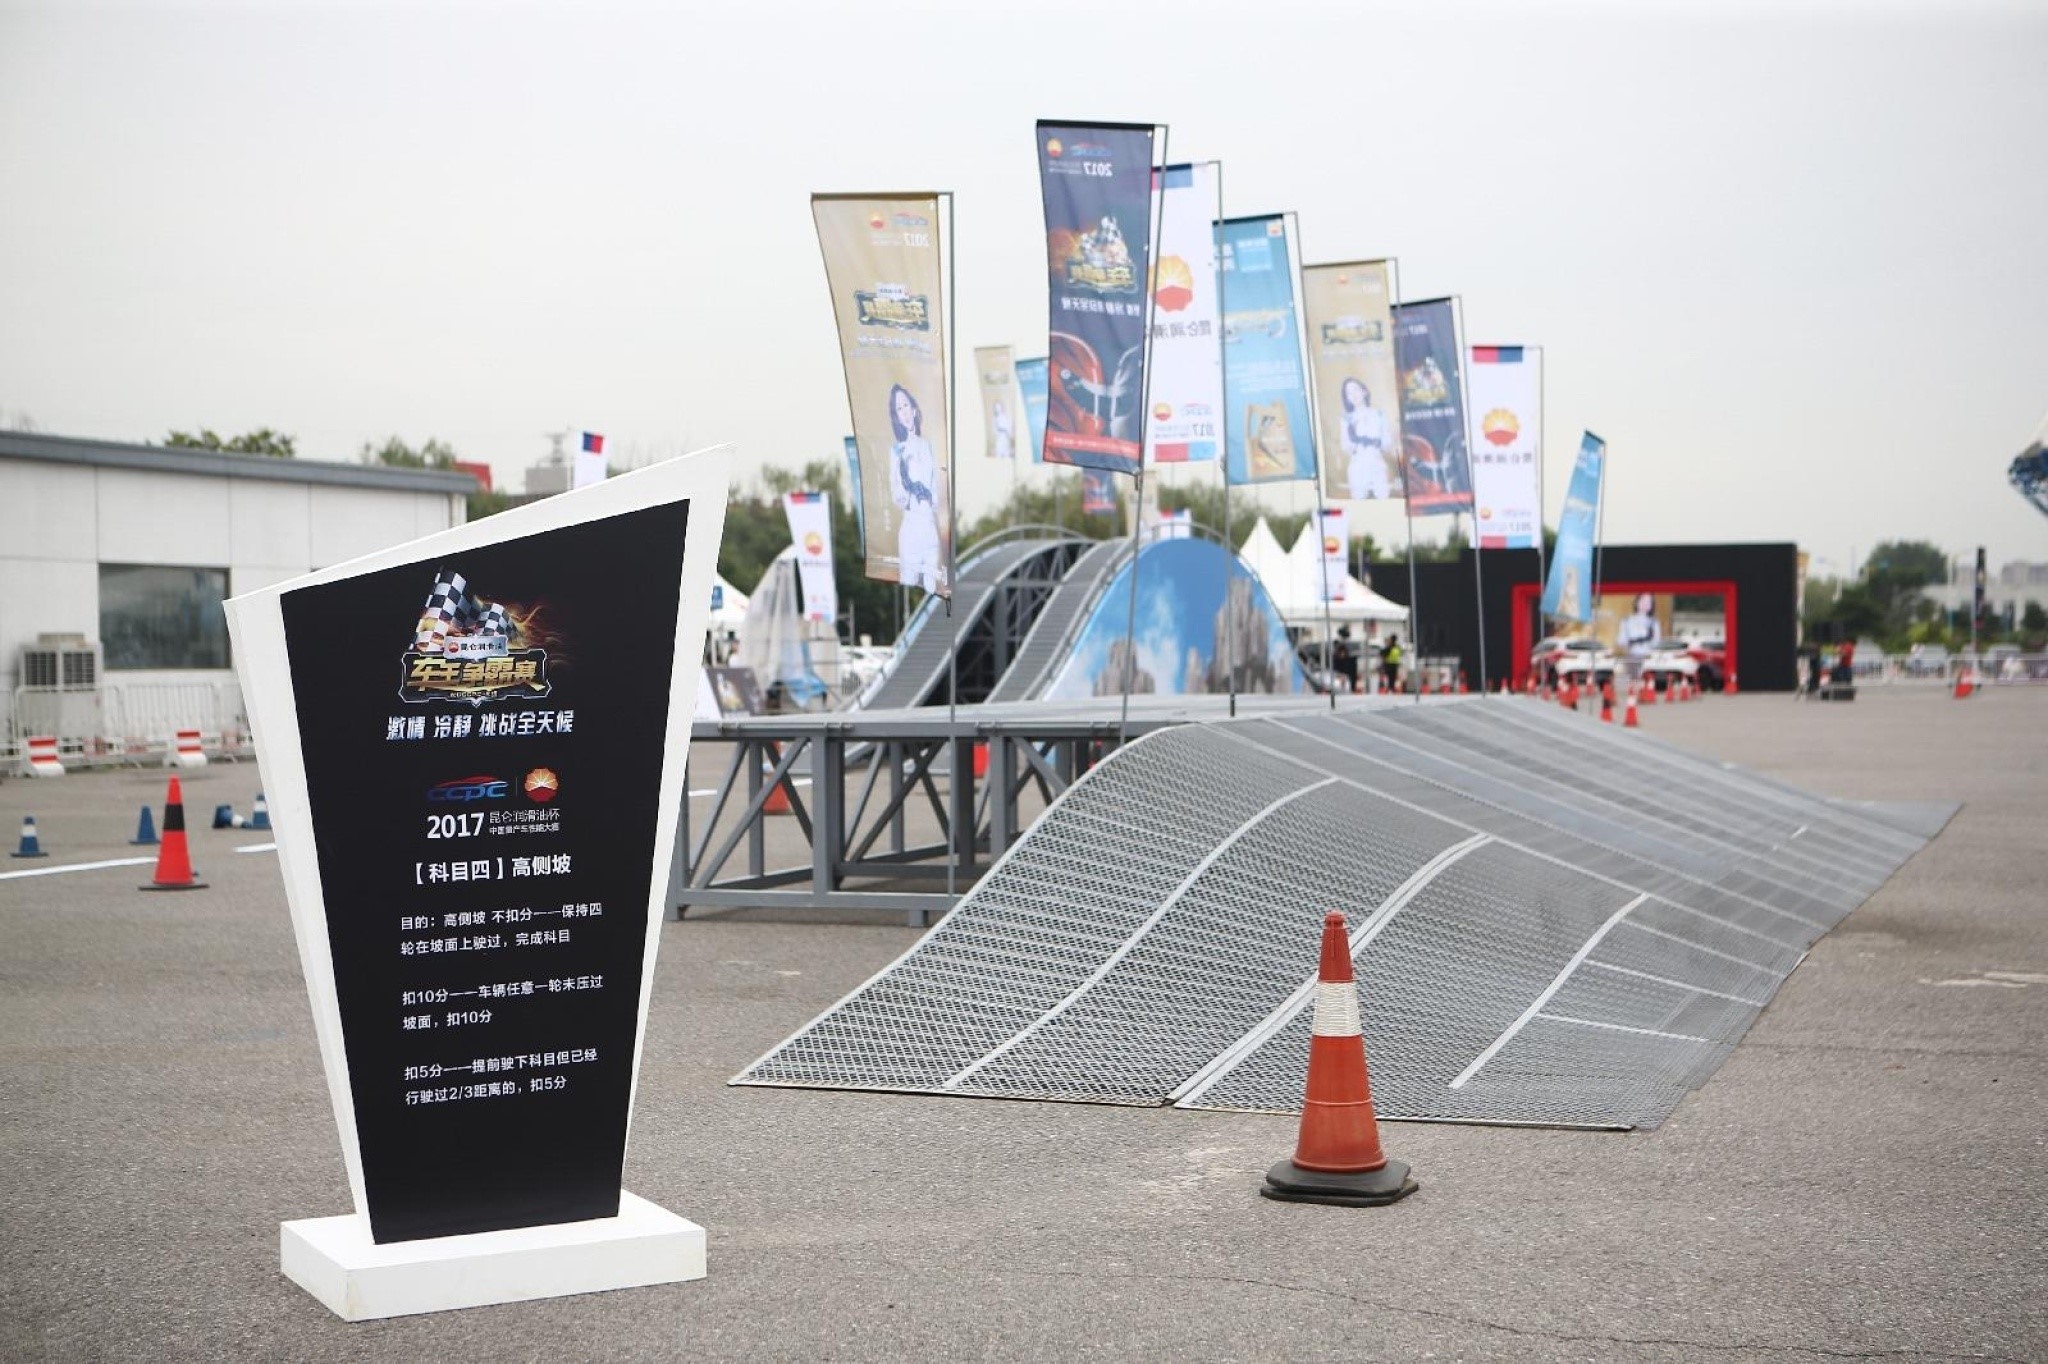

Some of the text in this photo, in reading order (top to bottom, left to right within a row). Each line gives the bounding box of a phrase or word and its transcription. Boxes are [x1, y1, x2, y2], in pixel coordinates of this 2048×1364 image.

[407, 657, 546, 691] 车王争霸赛
[386, 710, 575, 741] 激情 冷静 挑战全天候
[427, 812, 485, 839] 2017
[400, 929, 571, 956] 轮在坡面上驶过，完成科目
[402, 1009, 493, 1031] 坡面，扣10分
[405, 1075, 568, 1106] 行驶过2/3距离的，扣5分
